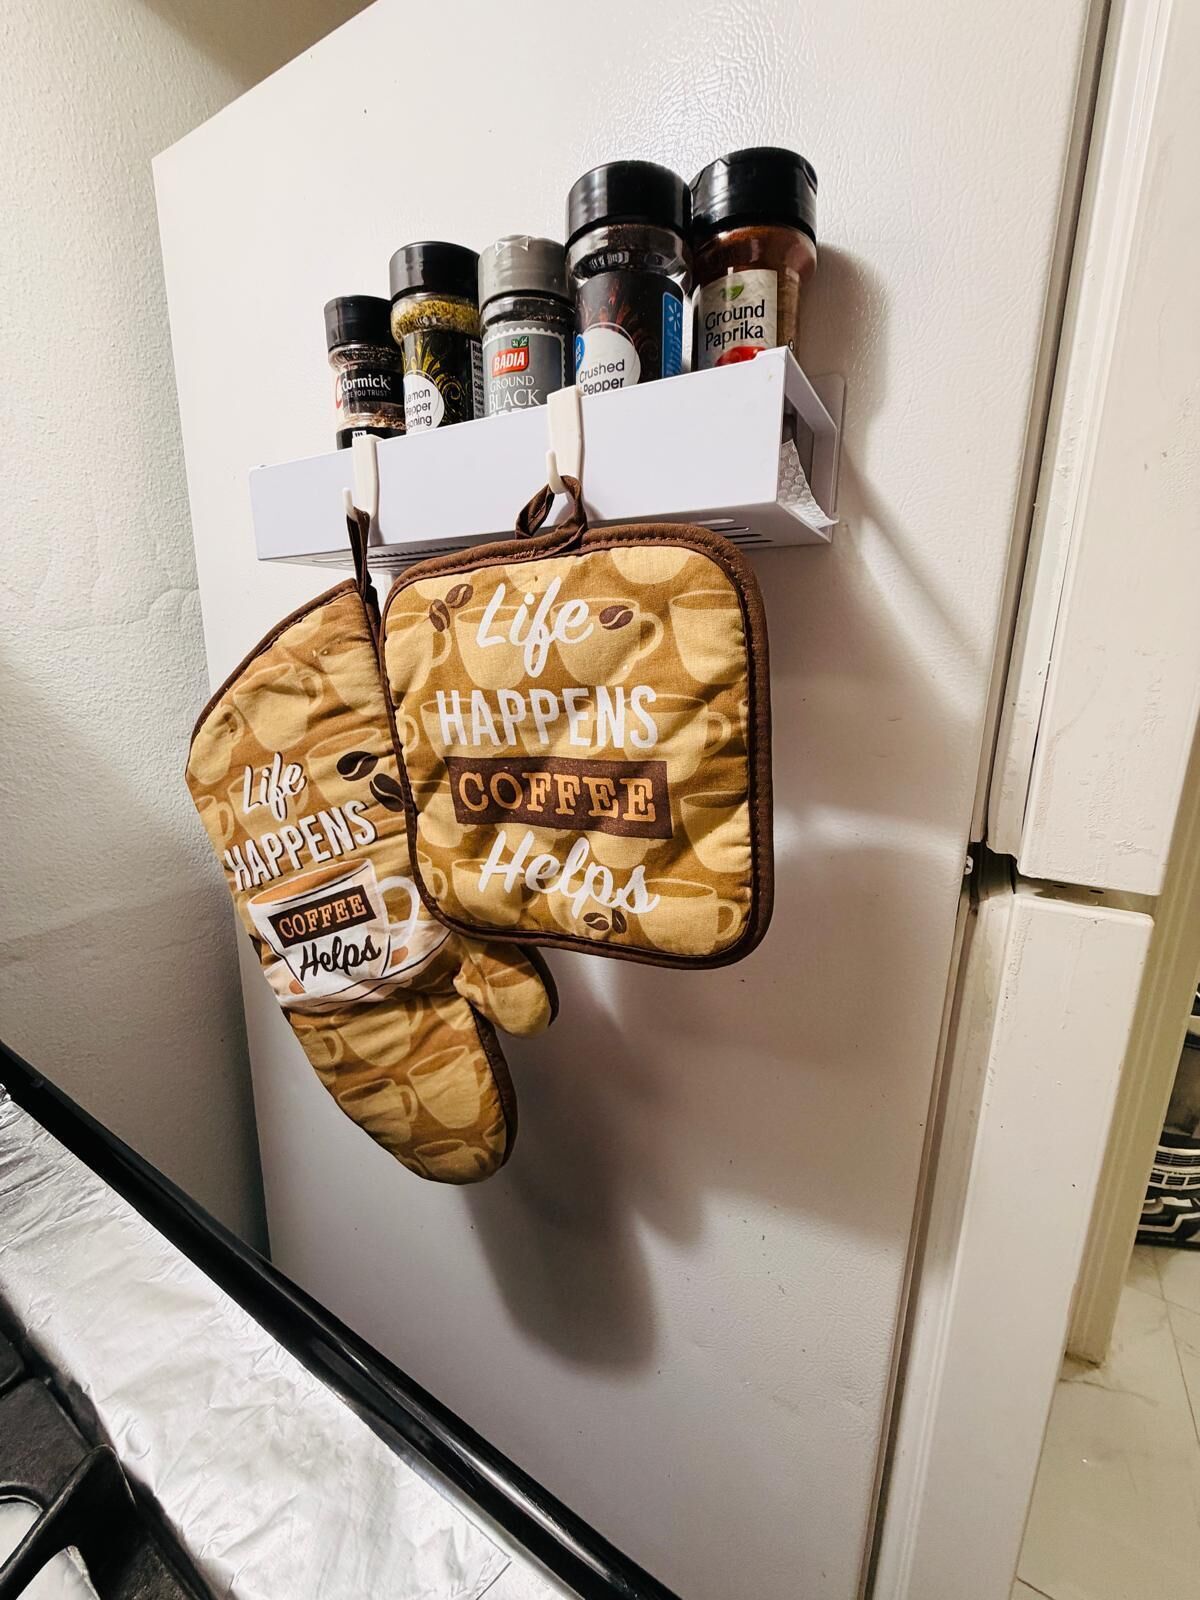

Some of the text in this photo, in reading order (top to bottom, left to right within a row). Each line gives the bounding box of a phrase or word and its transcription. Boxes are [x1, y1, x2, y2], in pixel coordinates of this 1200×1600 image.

[704, 299, 765, 332] Ground
[704, 319, 764, 350] Paprika
[342, 373, 390, 392] Cormick
[490, 375, 535, 393] GROUND
[493, 351, 525, 372] BADIA
[579, 358, 625, 384] Crushed
[489, 388, 541, 414] BLACK
[475, 575, 594, 679] Life
[435, 684, 658, 749] HAPPENS
[242, 750, 308, 822] Life
[458, 771, 658, 823] COFFEE
[224, 800, 378, 892] HAPPENS
[477, 829, 661, 920] Helps
[278, 893, 368, 940] COFFEE
[299, 934, 382, 982] Helps
